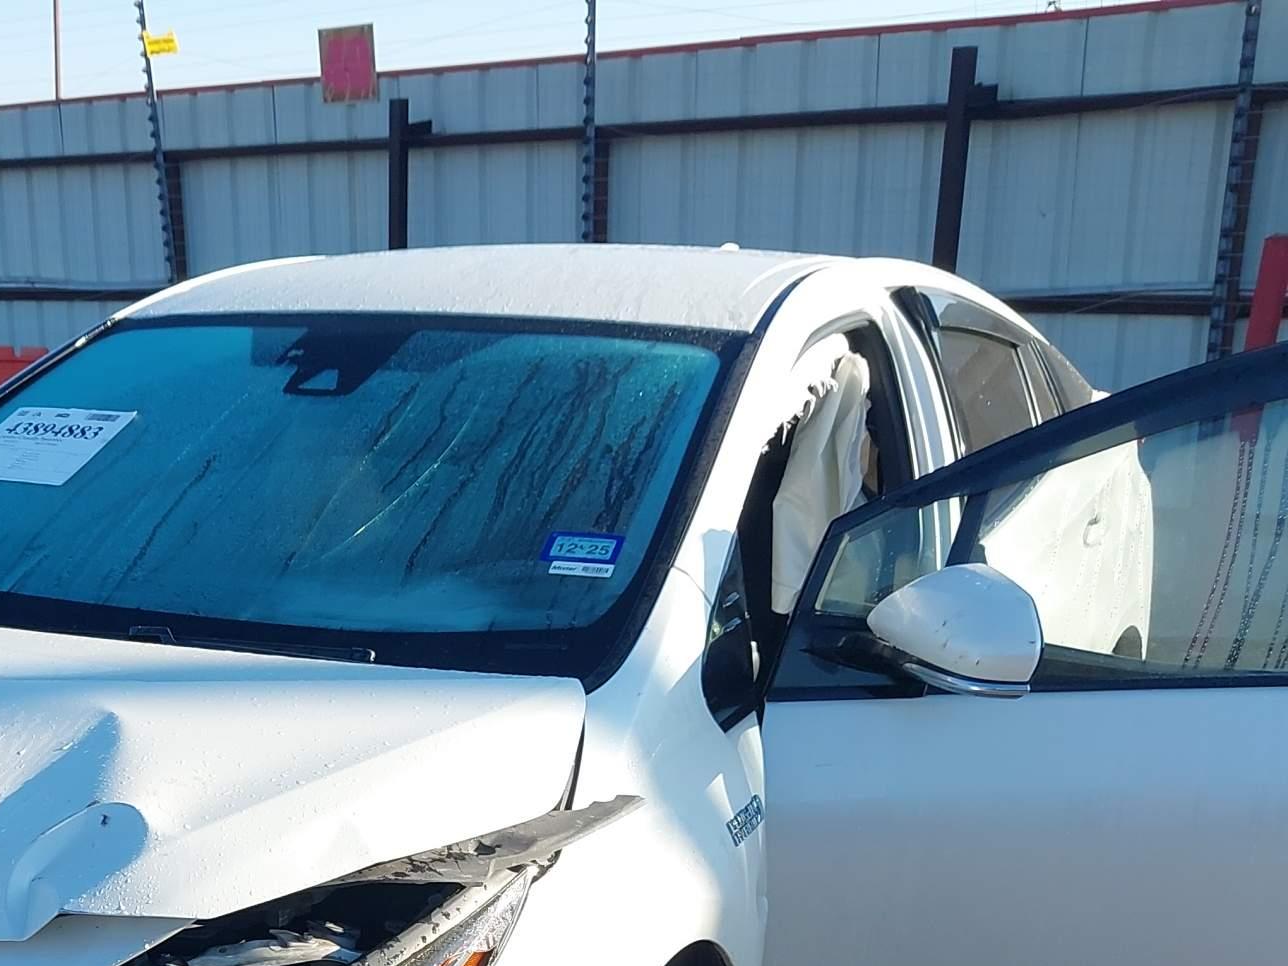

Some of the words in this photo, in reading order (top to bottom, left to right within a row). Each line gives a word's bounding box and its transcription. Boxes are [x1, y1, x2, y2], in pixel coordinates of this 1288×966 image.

[6, 422, 104, 440] 43894883
[557, 543, 577, 554] 12
[586, 544, 610, 556] 25
